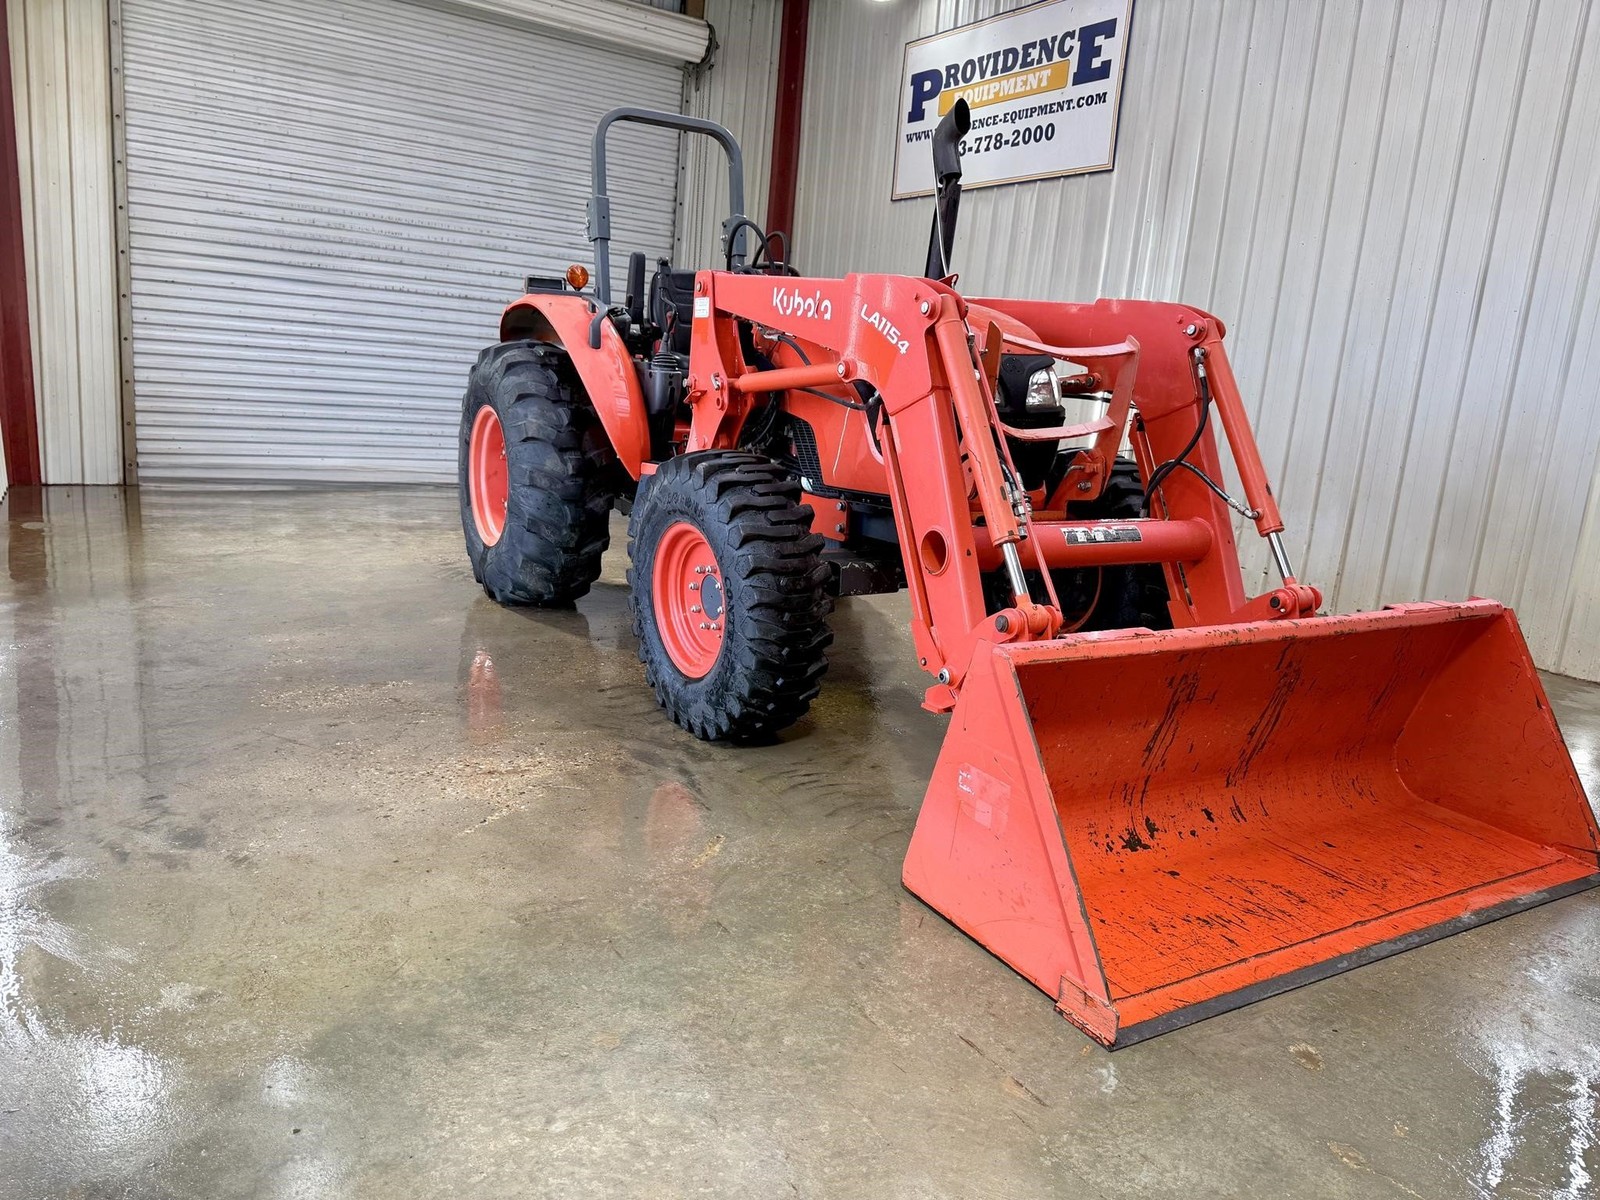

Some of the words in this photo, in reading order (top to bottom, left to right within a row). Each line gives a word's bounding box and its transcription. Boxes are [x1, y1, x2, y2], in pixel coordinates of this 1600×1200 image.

[907, 18, 1118, 123] PROVIDENCE
[772, 286, 832, 321] Kubota
[860, 303, 910, 355] LA1154
